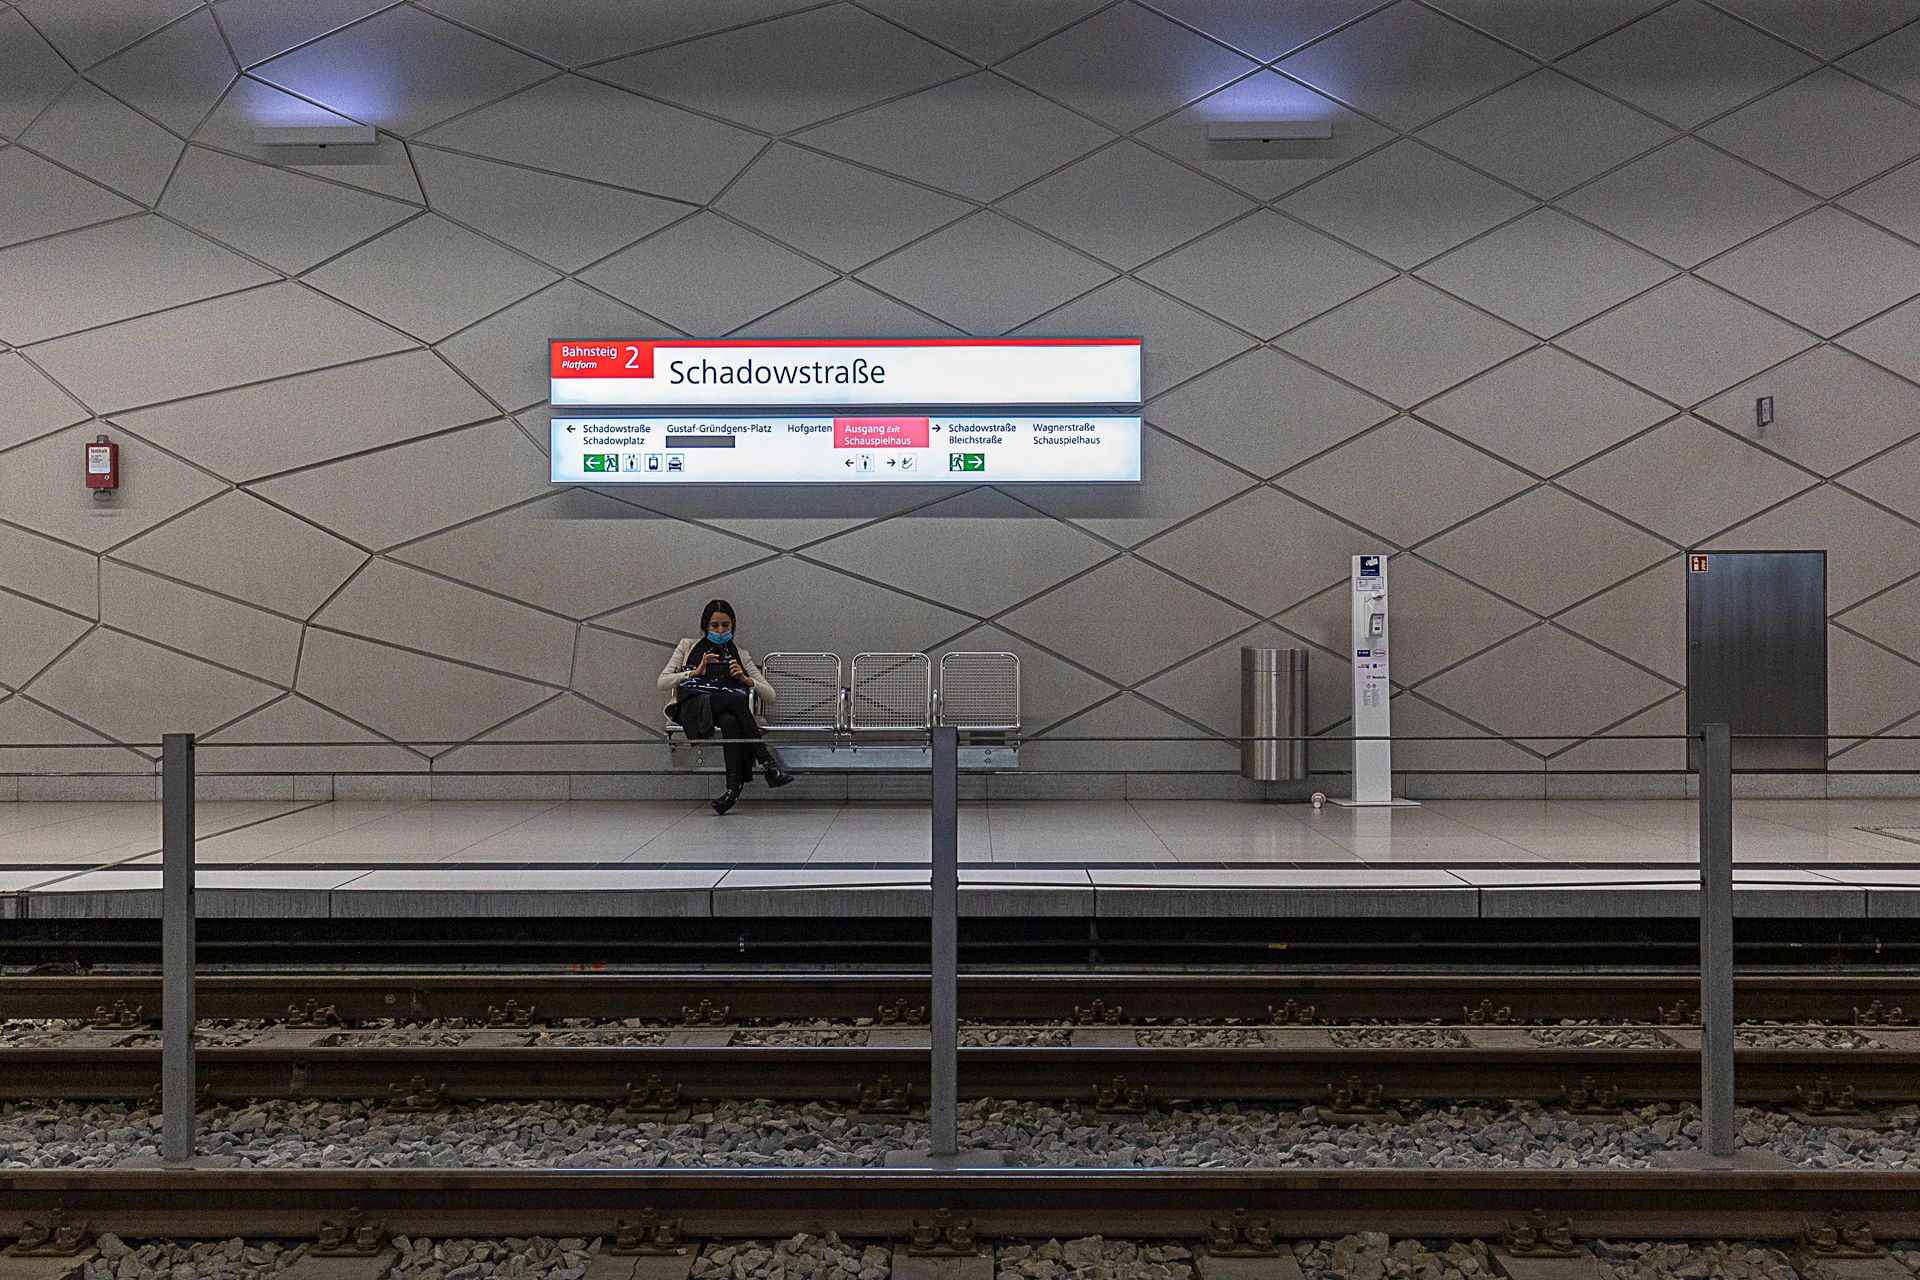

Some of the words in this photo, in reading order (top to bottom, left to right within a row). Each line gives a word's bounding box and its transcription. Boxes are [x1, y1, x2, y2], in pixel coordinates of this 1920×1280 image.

[562, 346, 618, 358] Bahnsteig
[624, 346, 640, 369] 2
[562, 360, 598, 370] Platform
[670, 358, 885, 385] Schadowstraße
[583, 423, 651, 434] Schadowstraße
[666, 423, 772, 435] Gustaf-Gründgens-Platz
[787, 423, 833, 435] Hofgarten
[844, 424, 885, 435] Ausgang
[886, 425, 901, 433] Exit
[948, 422, 1017, 433] Schadowstraße
[1032, 422, 1096, 434] Wagnerstraße
[583, 436, 645, 447] Schadowplatz
[844, 435, 912, 446] Schauspielhaus
[949, 434, 1003, 445] Bleichstraße
[1033, 435, 1101, 446] Schauspielhaus
